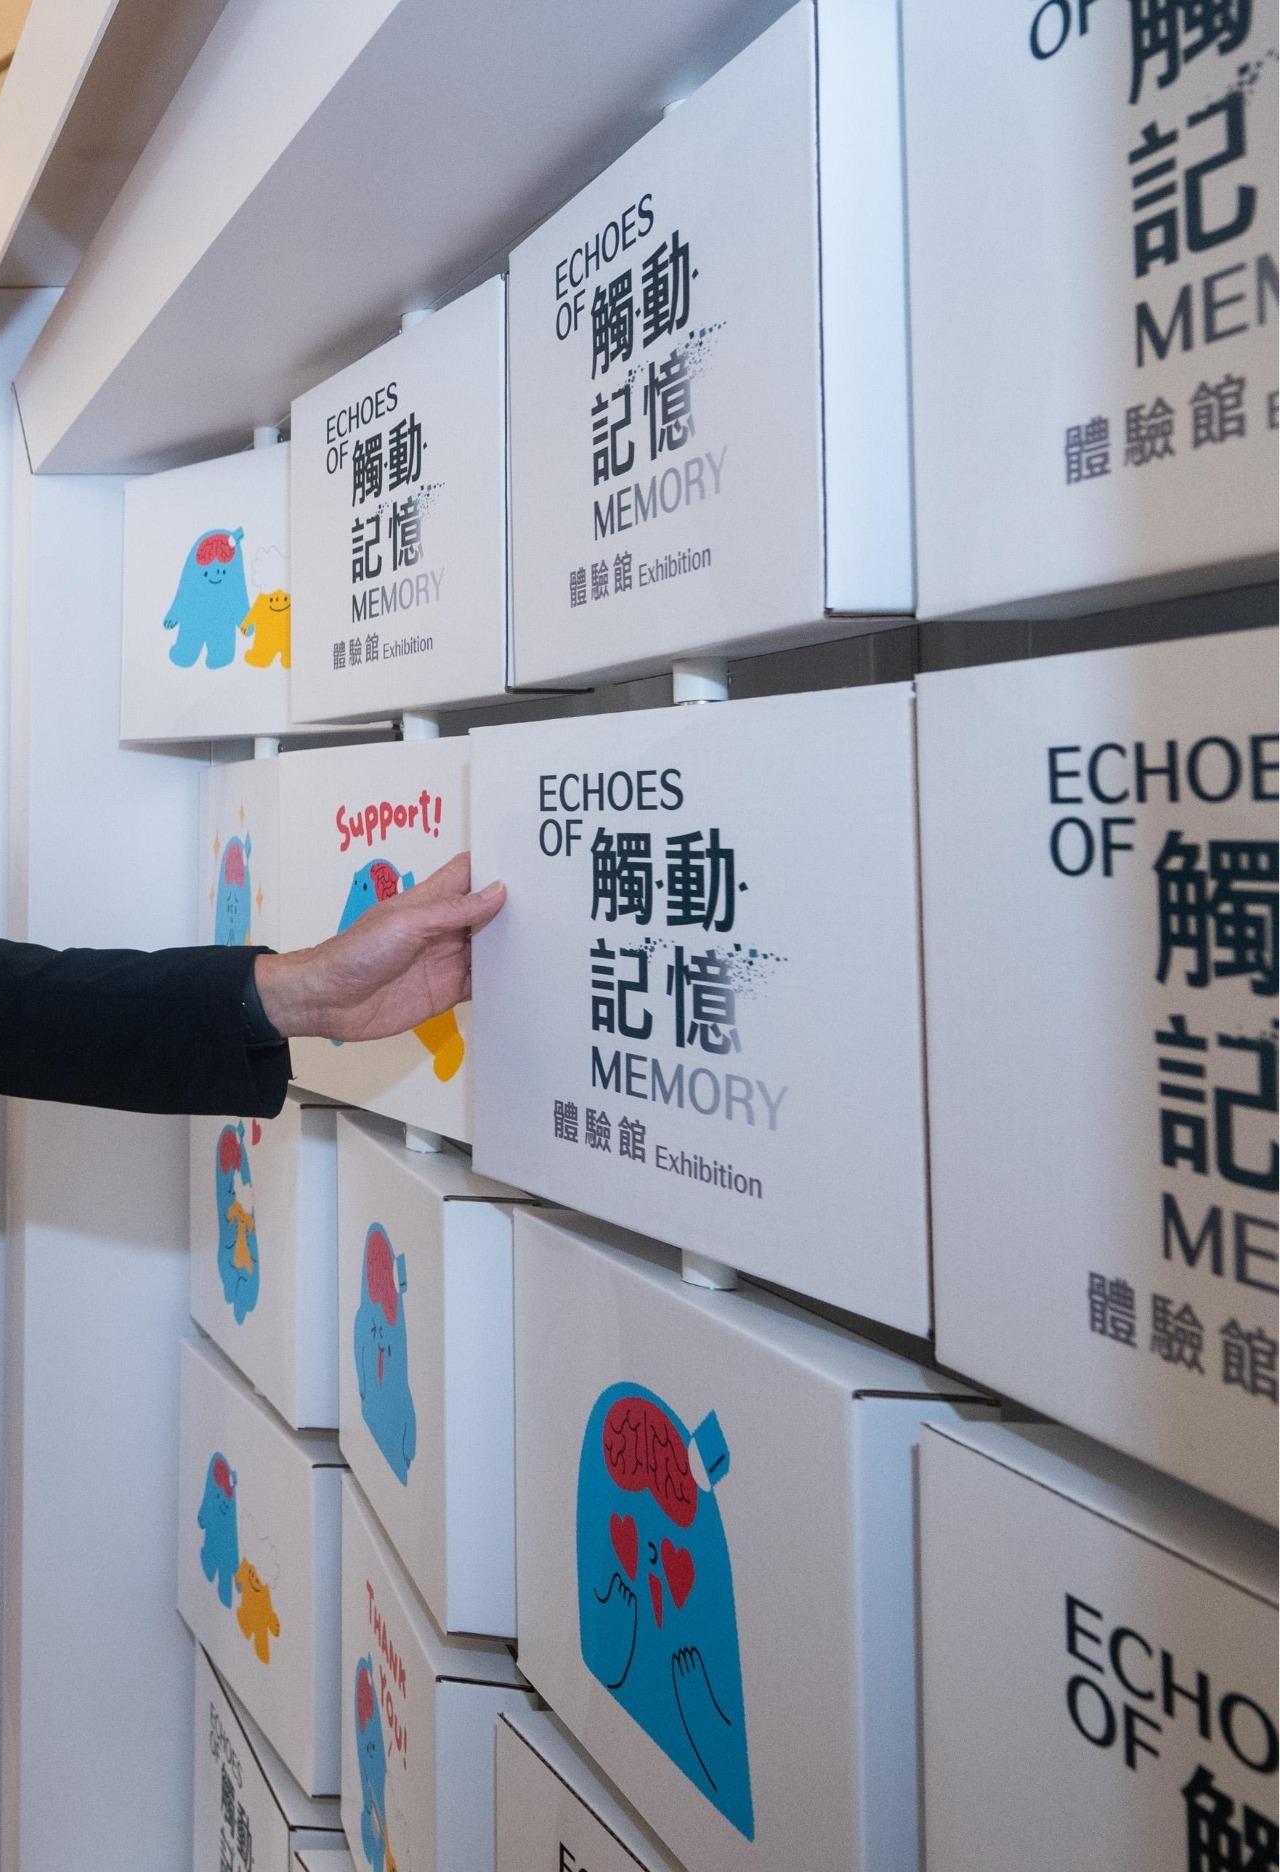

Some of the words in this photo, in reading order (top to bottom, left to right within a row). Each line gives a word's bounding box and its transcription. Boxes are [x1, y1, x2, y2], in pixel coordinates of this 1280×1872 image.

[1128, 90, 1257, 279] 記
[556, 193, 655, 301] ECHOES
[556, 288, 586, 342] OF
[326, 381, 399, 445] ECHOES
[326, 440, 350, 475] OF
[591, 350, 697, 488] 記憶
[1065, 374, 1247, 486] 體驗館
[593, 445, 730, 541] MEMORY
[351, 495, 424, 584] 記憶
[569, 550, 634, 609] 體驗館
[638, 547, 712, 588] Exhibition
[352, 567, 446, 625] MEMORY
[333, 633, 380, 670] 體驗館
[382, 635, 434, 660] Exhibition
[336, 790, 442, 852] Support!
[539, 768, 685, 813] ECHOES
[539, 818, 583, 857] OF
[1049, 815, 1137, 878] OF
[590, 938, 743, 1055] 記憶
[592, 1045, 789, 1132] MEMORY
[553, 1099, 647, 1164] 體驗館
[655, 1145, 763, 1200] Exhibition
[1087, 1271, 1278, 1402] 體驗館
[366, 1580, 407, 1698] THANK
[1065, 1591, 1278, 1775] ECHO
[379, 1664, 407, 1770] YOU!
[1066, 1674, 1163, 1770] OF
